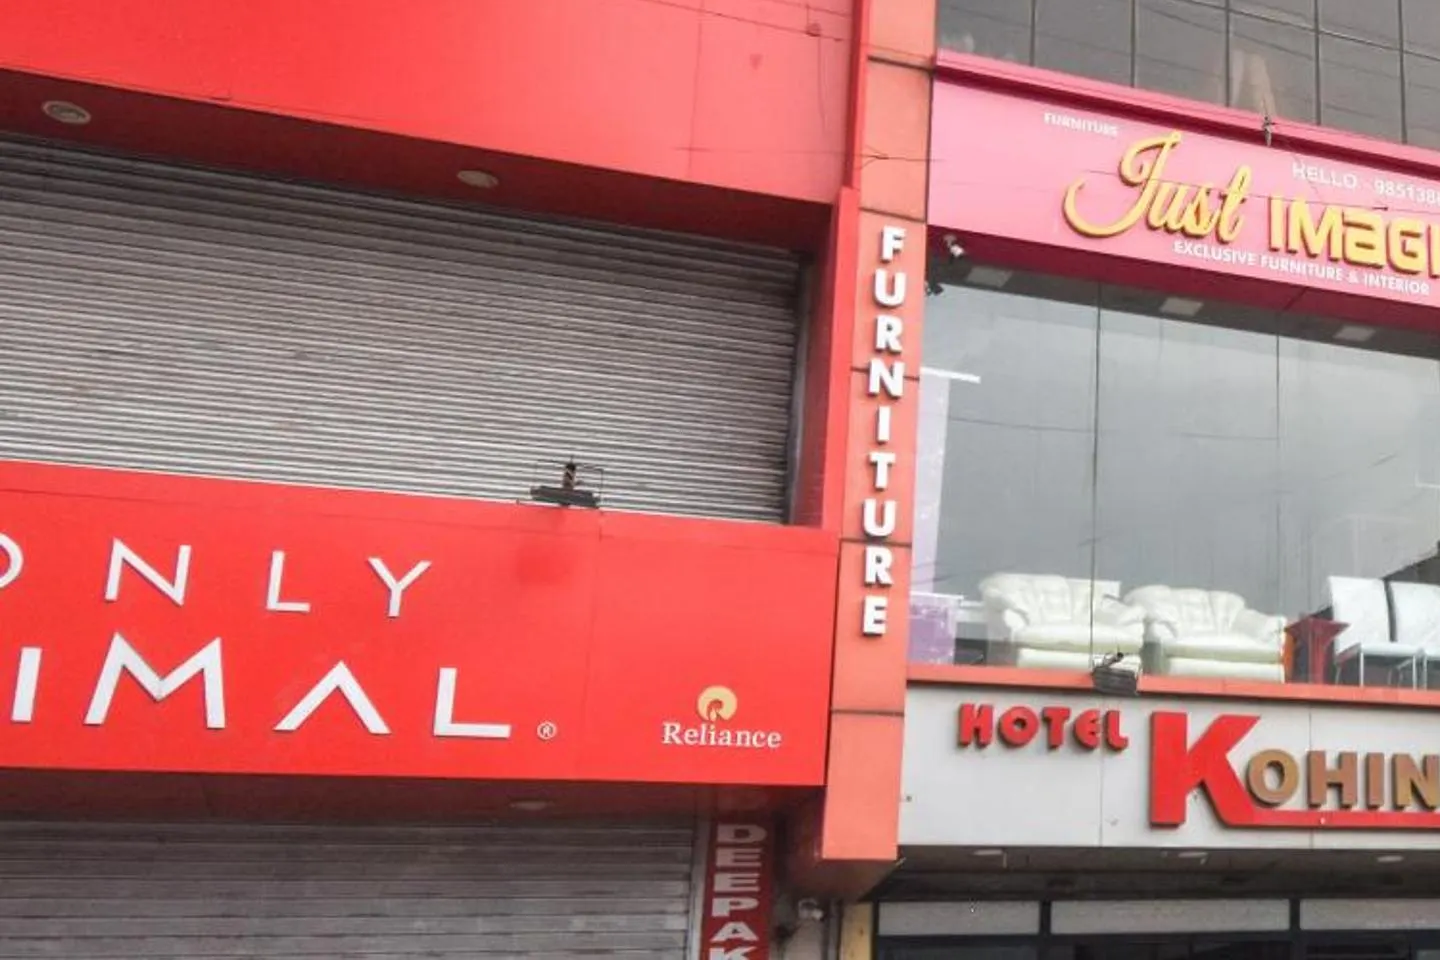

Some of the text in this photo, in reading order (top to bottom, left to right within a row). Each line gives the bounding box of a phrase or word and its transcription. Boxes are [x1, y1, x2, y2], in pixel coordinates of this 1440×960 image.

[1064, 128, 1253, 245] Just
[1173, 238, 1257, 268] EXCLUSIVE
[1260, 252, 1346, 283] FURNITURE
[1363, 272, 1430, 297] INTERIOR
[862, 224, 907, 638] FURNITURE
[0, 532, 432, 618] NLY
[660, 719, 783, 751] Reliance
[958, 702, 1130, 752] HOTEL
